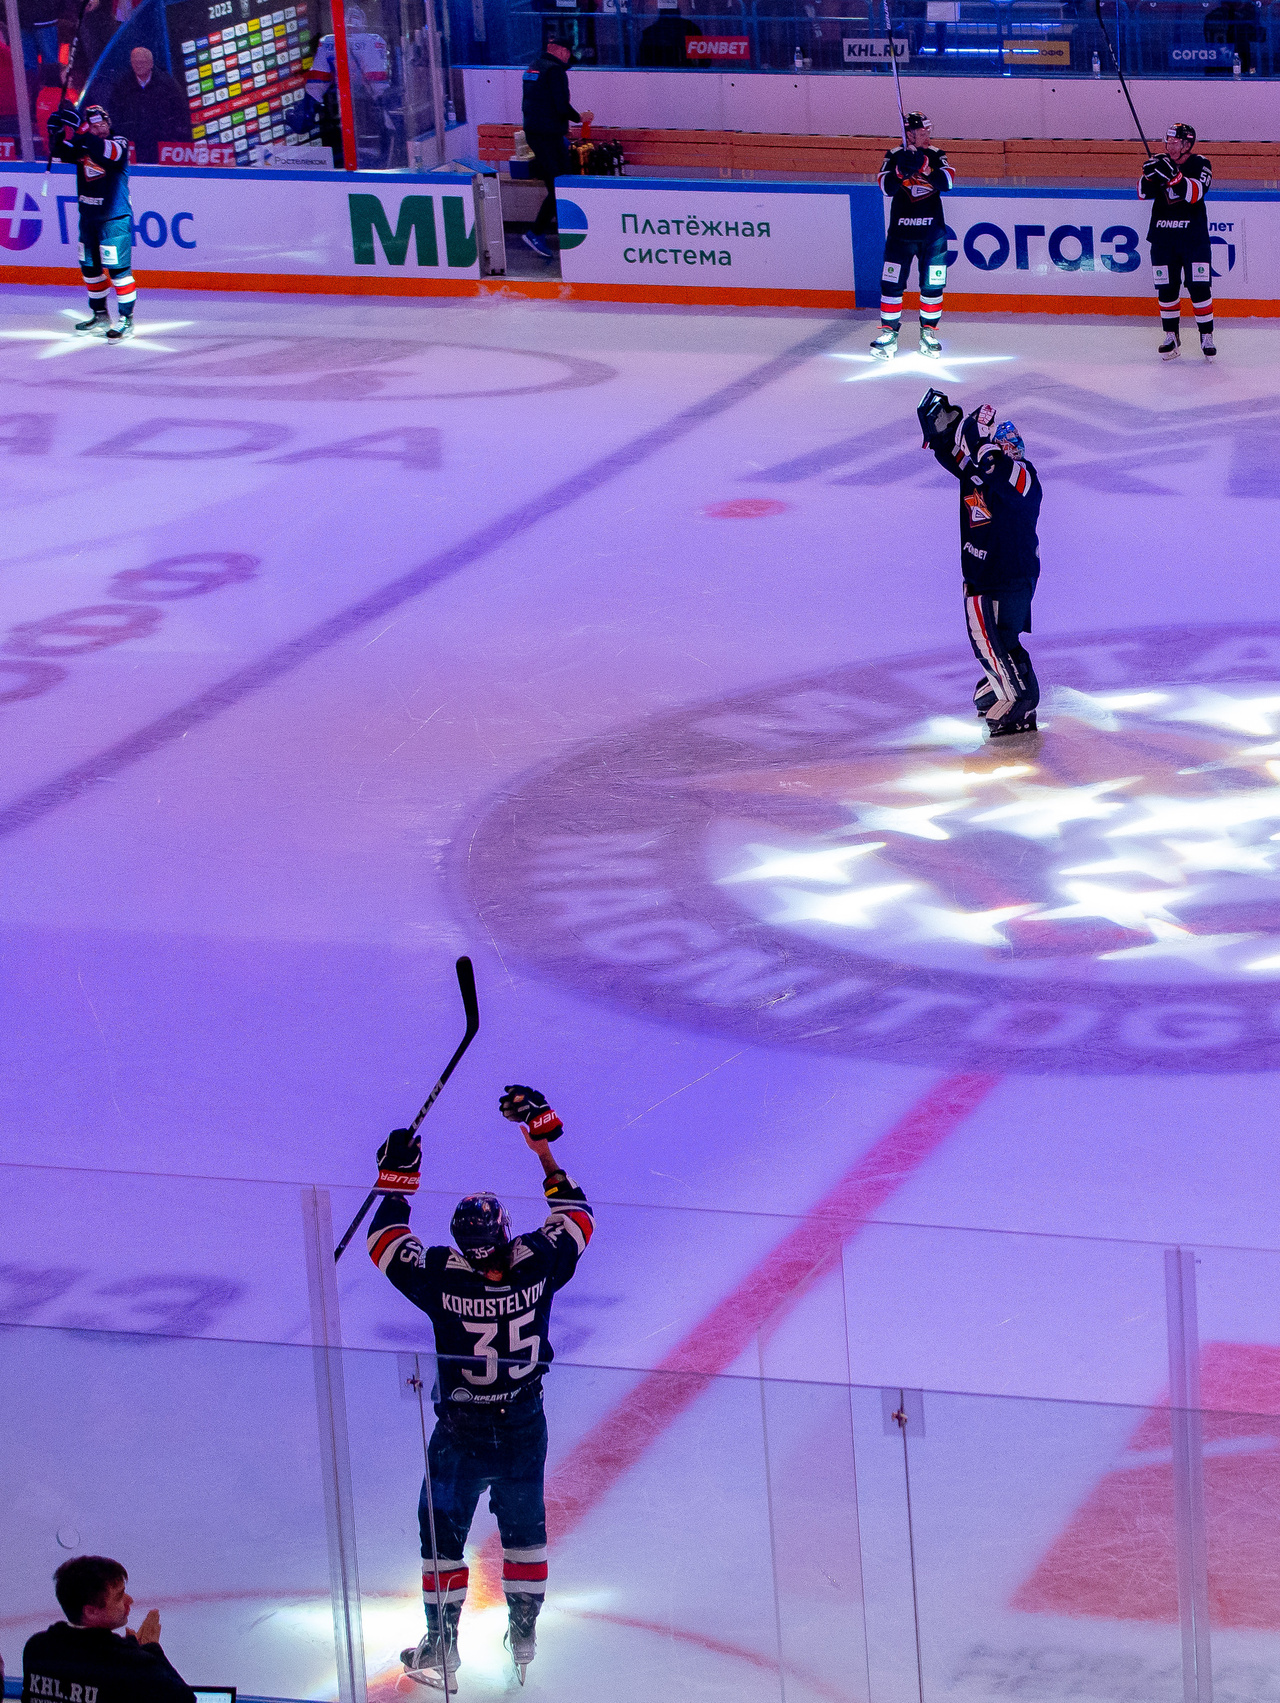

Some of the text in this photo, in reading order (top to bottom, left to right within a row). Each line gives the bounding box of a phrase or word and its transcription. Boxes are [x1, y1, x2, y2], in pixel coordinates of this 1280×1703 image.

[208, 1, 232, 19] 2023
[688, 41, 748, 54] FONBET
[847, 44, 904, 57] KHL.RU
[160, 146, 232, 165] FONBET
[621, 213, 771, 238] Платёжная
[897, 217, 934, 227] FONBET
[1156, 219, 1191, 229] FONBET
[623, 247, 732, 266] система
[945, 221, 1142, 274] огаз
[474, 1247, 489, 1259] 35
[441, 1276, 547, 1318] KOROSTELYOV
[461, 1308, 541, 1386] 35
[29, 1672, 99, 1703] KHL.RU
